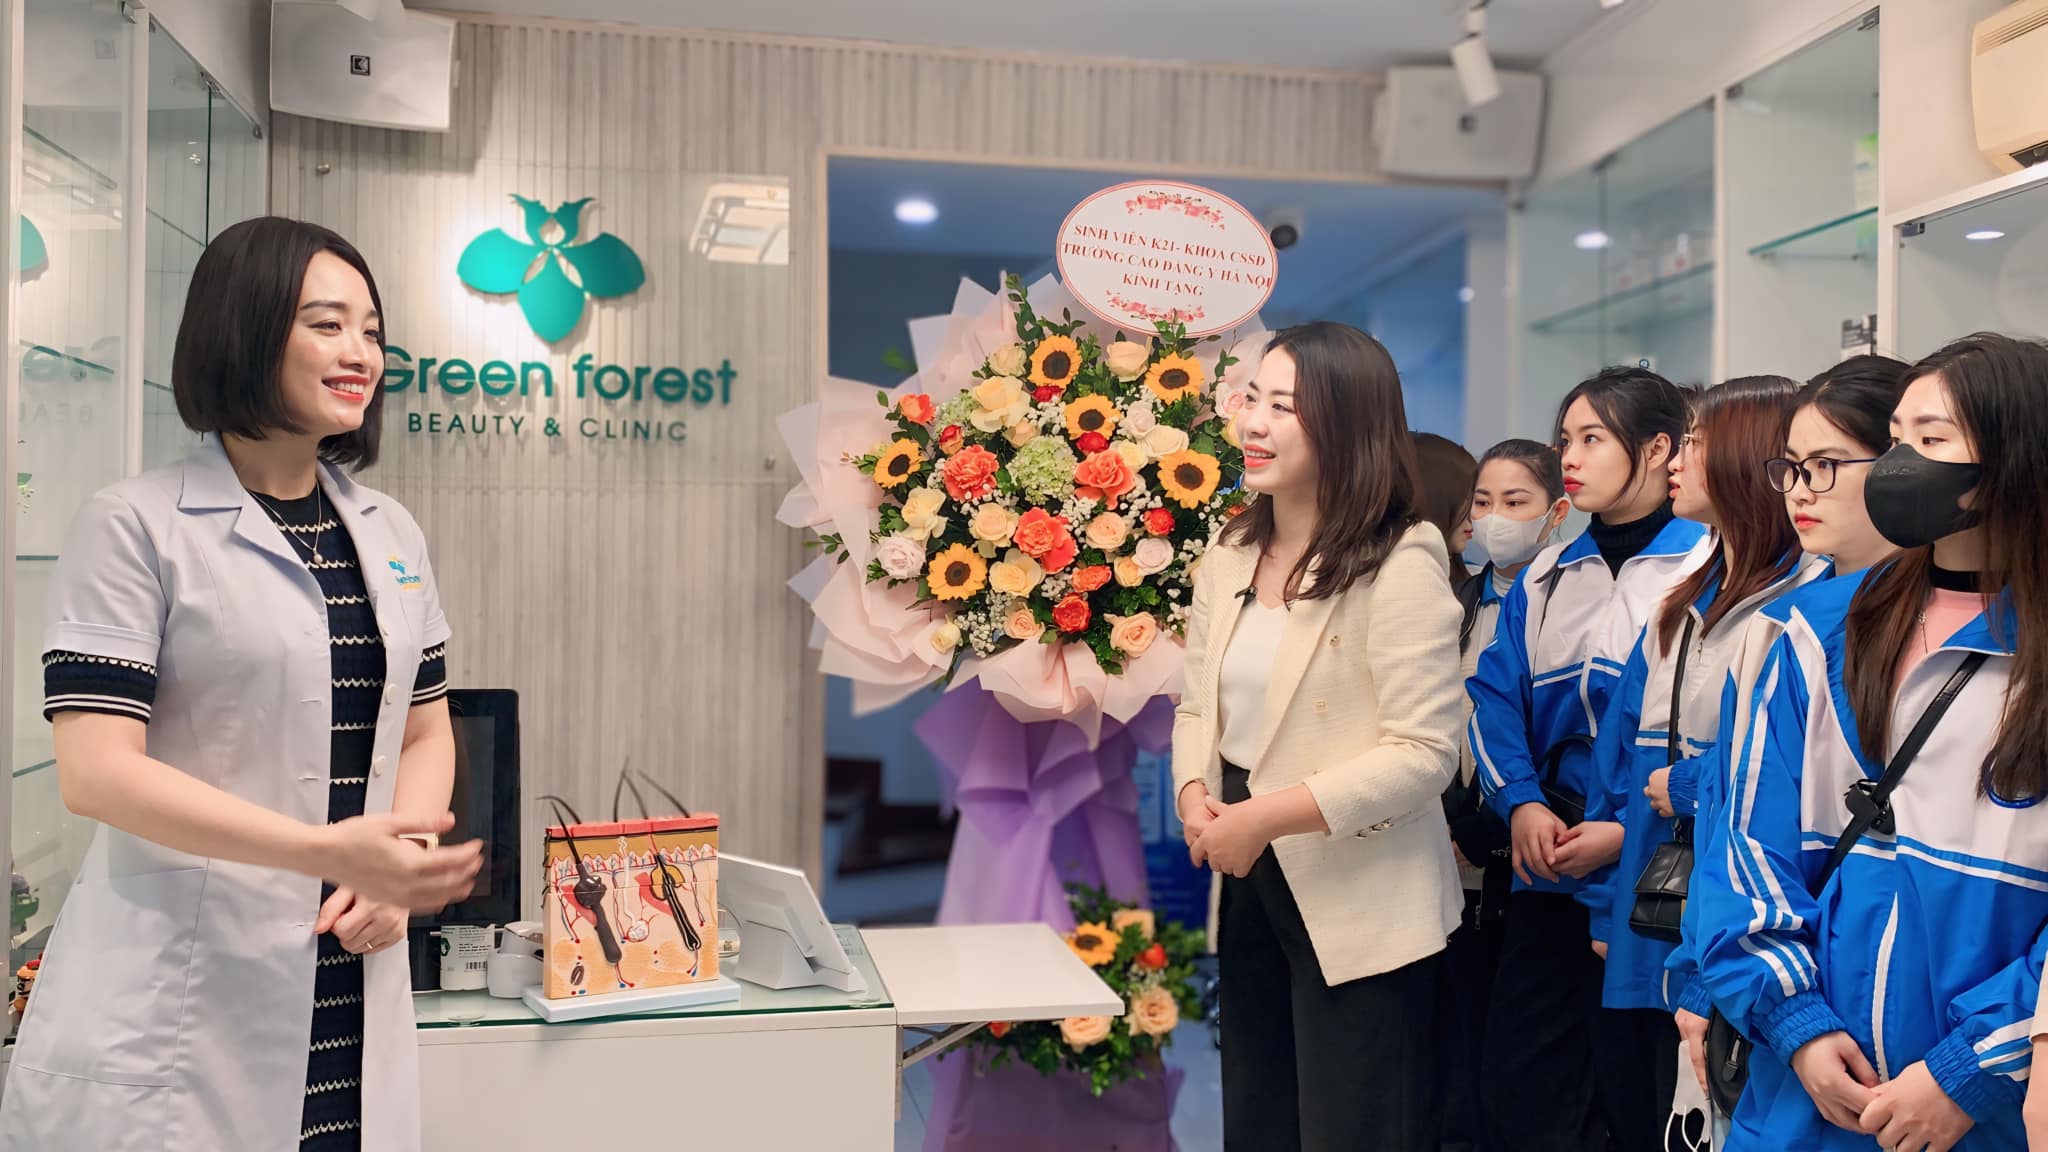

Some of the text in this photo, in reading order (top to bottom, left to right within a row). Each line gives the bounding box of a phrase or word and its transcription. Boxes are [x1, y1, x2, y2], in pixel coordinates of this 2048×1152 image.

[1074, 225, 1108, 240] SINH
[1114, 232, 1147, 246] VIÊN
[1184, 243, 1225, 260] KHOA
[1128, 254, 1159, 268] CAO
[1207, 266, 1218, 279] Y
[384, 345, 738, 405] Green forest
[408, 412, 688, 441] BEAUTY & CLINIC
